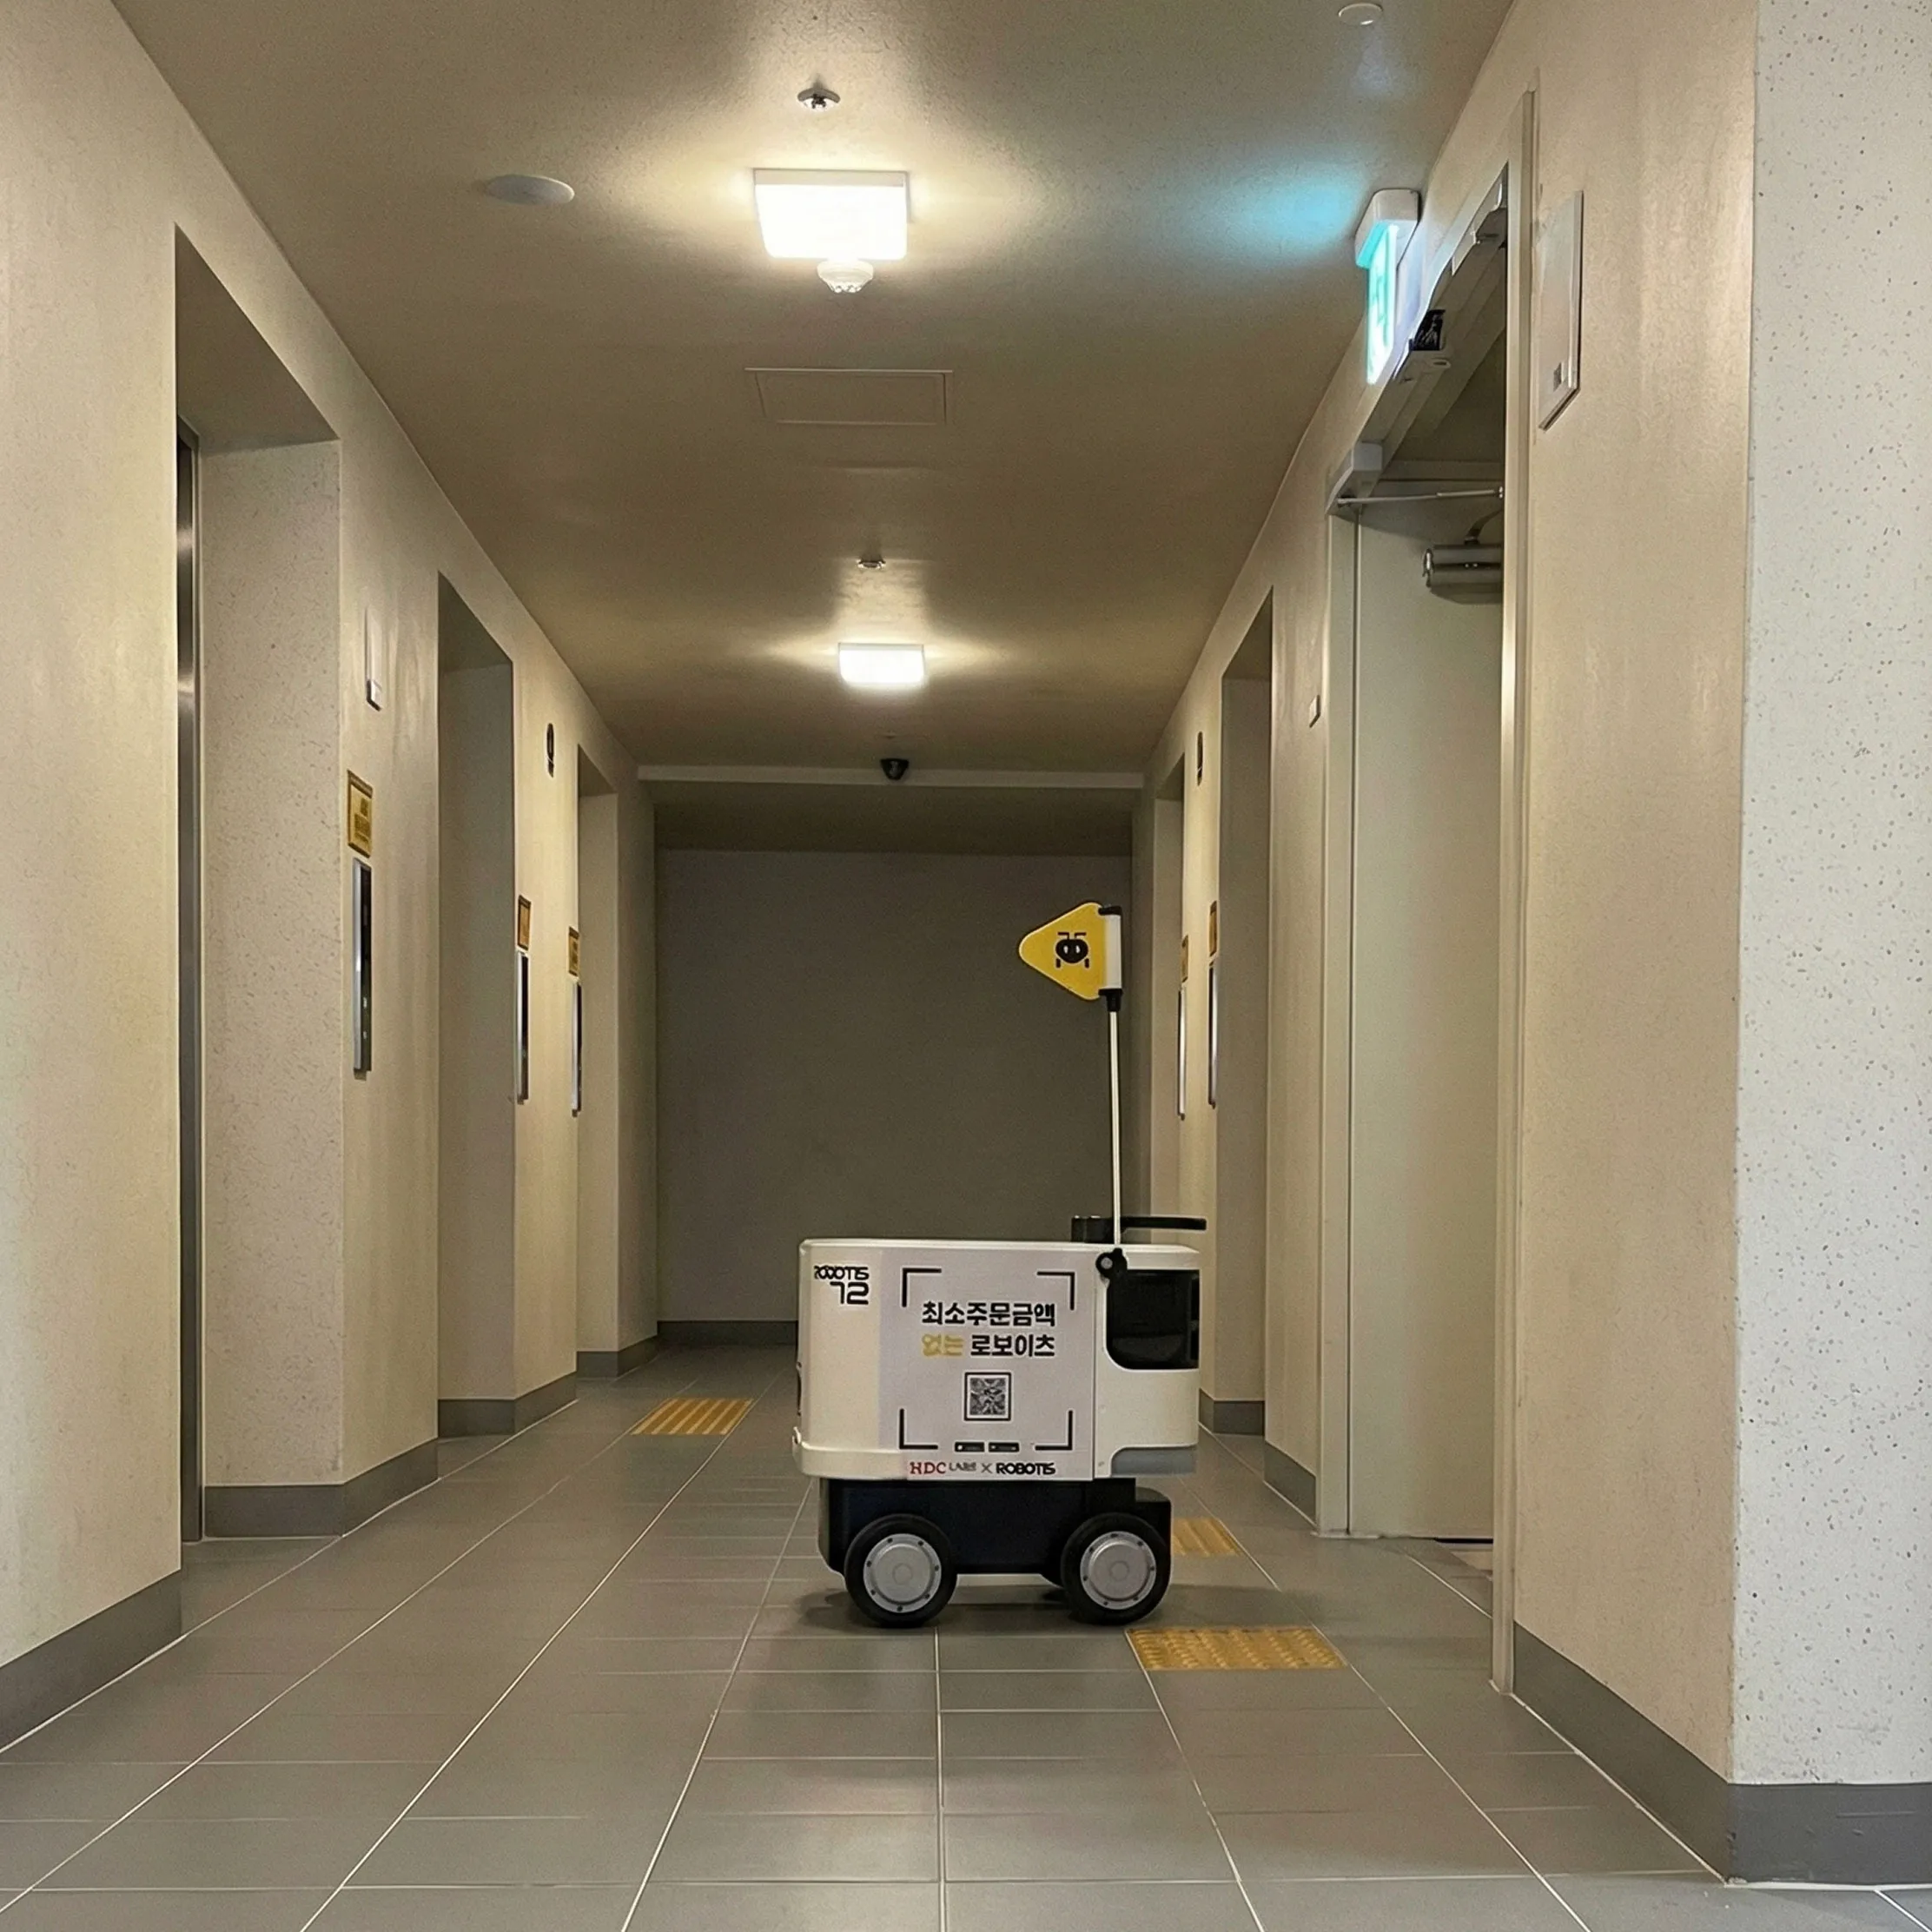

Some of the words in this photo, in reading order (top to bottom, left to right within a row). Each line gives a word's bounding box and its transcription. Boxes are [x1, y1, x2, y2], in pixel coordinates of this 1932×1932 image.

[830, 1281, 870, 1305] 72
[922, 1300, 1055, 1327] 최소주문금액
[922, 1333, 964, 1357] 없는
[970, 1333, 1055, 1357] 로보이츠
[910, 1461, 947, 1474] HDC
[996, 1462, 1056, 1475] ROBOTIS
